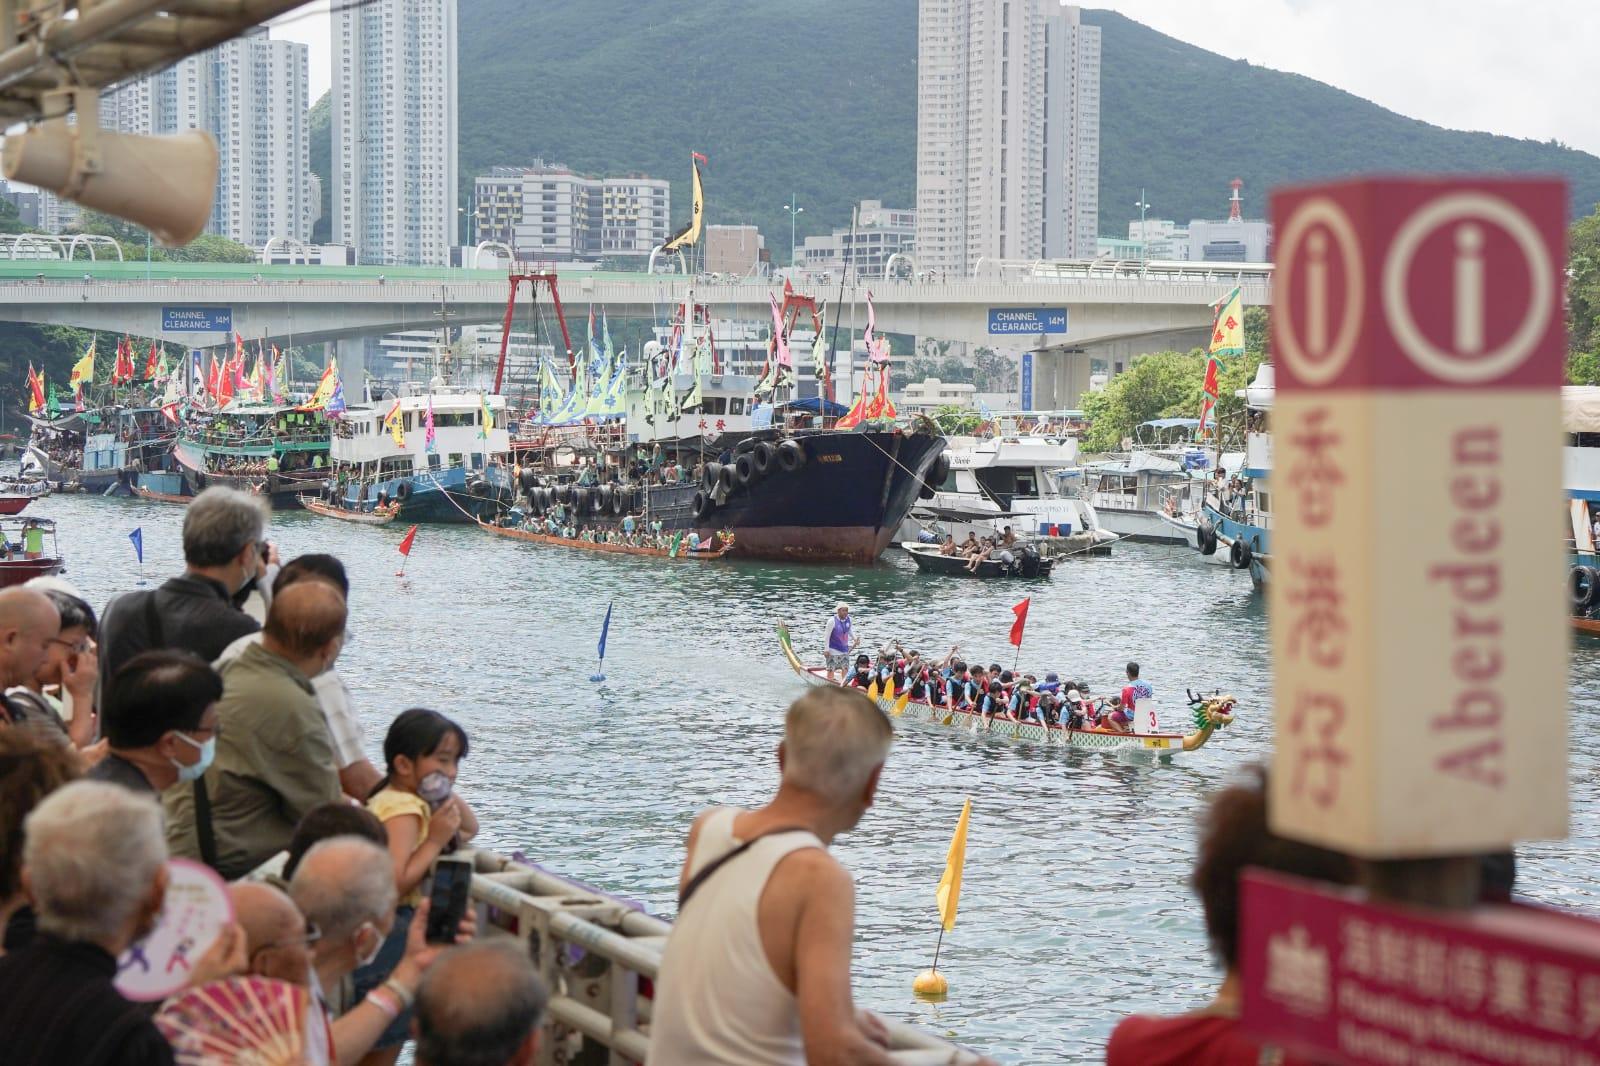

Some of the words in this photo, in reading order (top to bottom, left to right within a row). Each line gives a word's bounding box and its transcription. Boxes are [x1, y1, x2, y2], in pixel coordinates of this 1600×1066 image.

[169, 311, 206, 319] CHANNEL
[215, 315, 230, 324] 14M
[996, 312, 1038, 321] CHANNEL
[164, 320, 211, 329] CLEARANCE
[1048, 316, 1065, 326] 14M
[990, 322, 1044, 331] CLEARANCE
[1428, 424, 1506, 791] Aberdeen
[1149, 711, 1157, 727] 3
